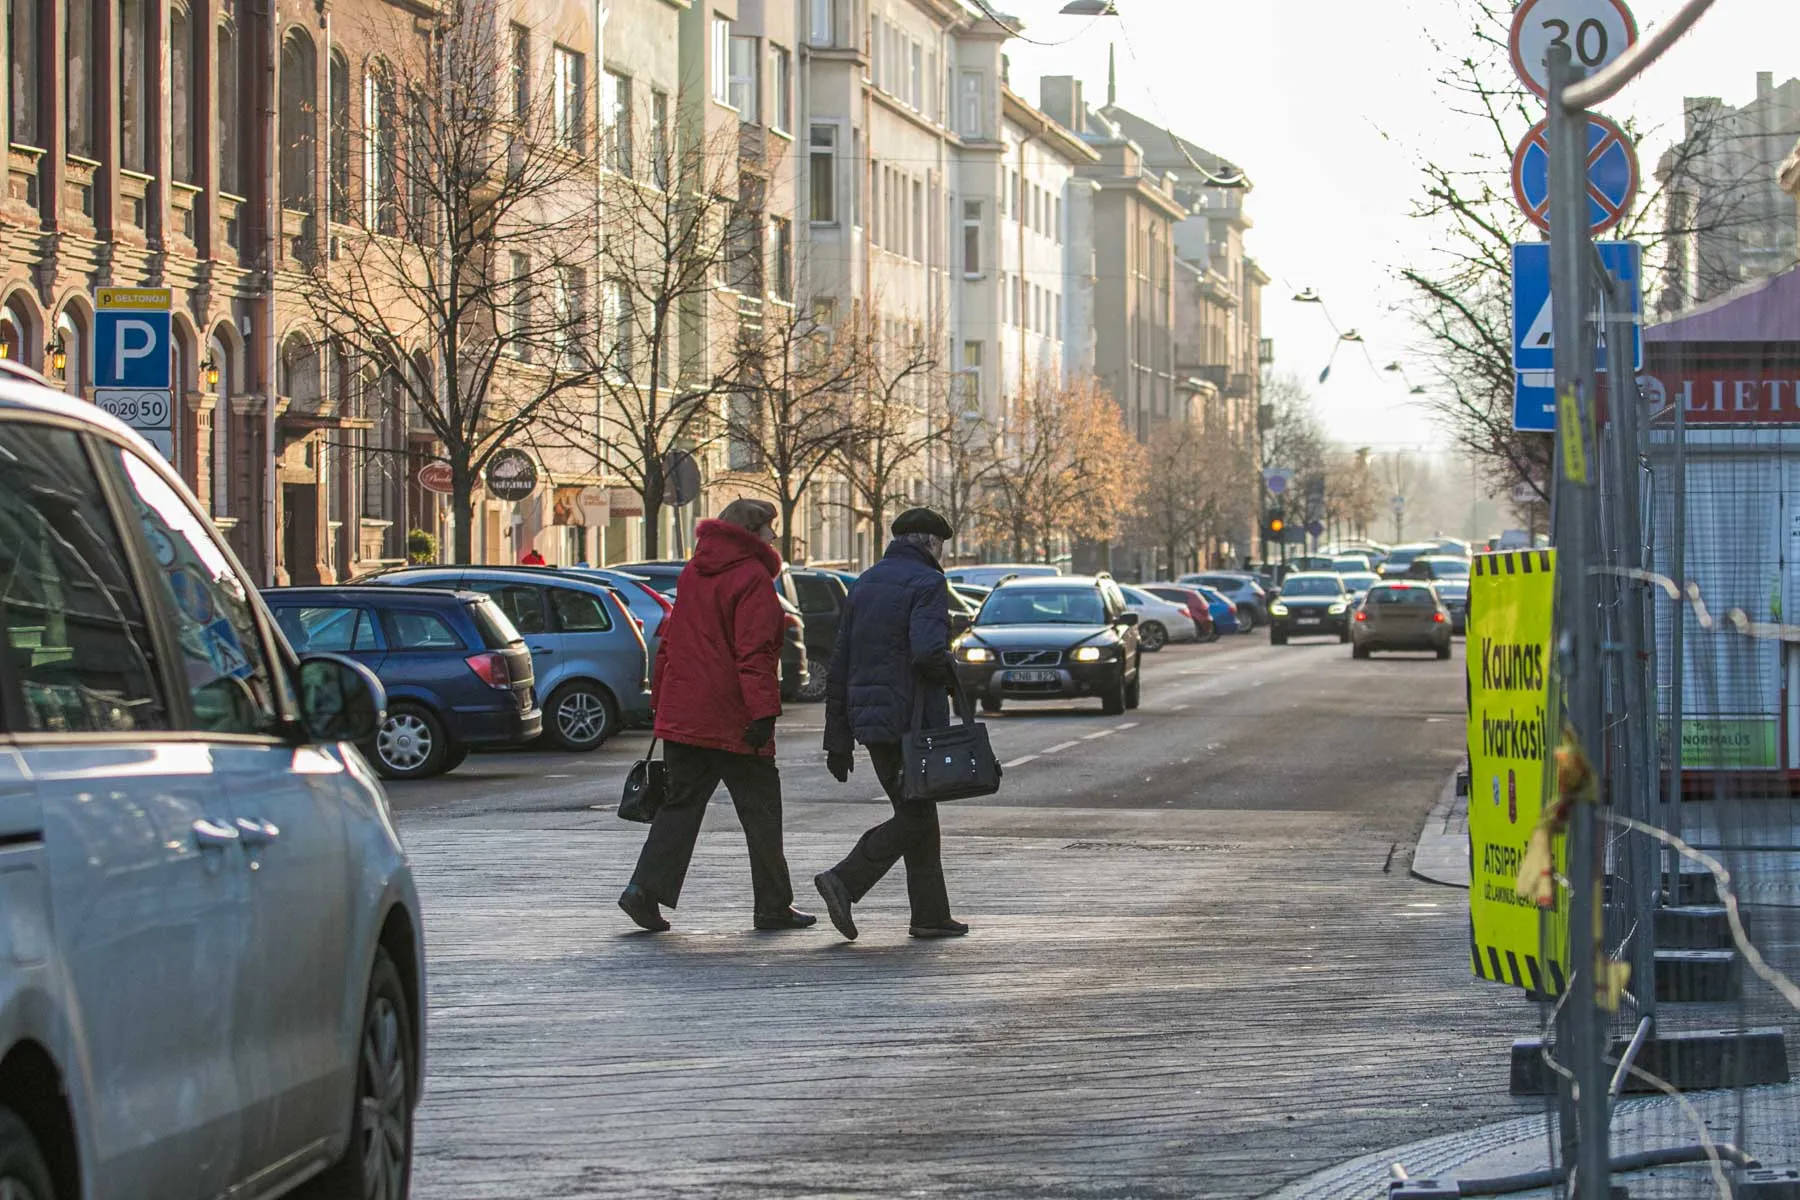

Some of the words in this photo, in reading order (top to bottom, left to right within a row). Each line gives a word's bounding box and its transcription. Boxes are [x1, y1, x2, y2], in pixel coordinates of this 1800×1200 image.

[1542, 18, 1608, 67] 30
[116, 320, 156, 379] P
[103, 403, 117, 415] 10
[121, 403, 137, 415] 20
[141, 401, 162, 416] 50
[1682, 380, 1800, 412] LIET
[1482, 637, 1542, 691] Kaunas
[1483, 706, 1546, 760] tvarkosi!
